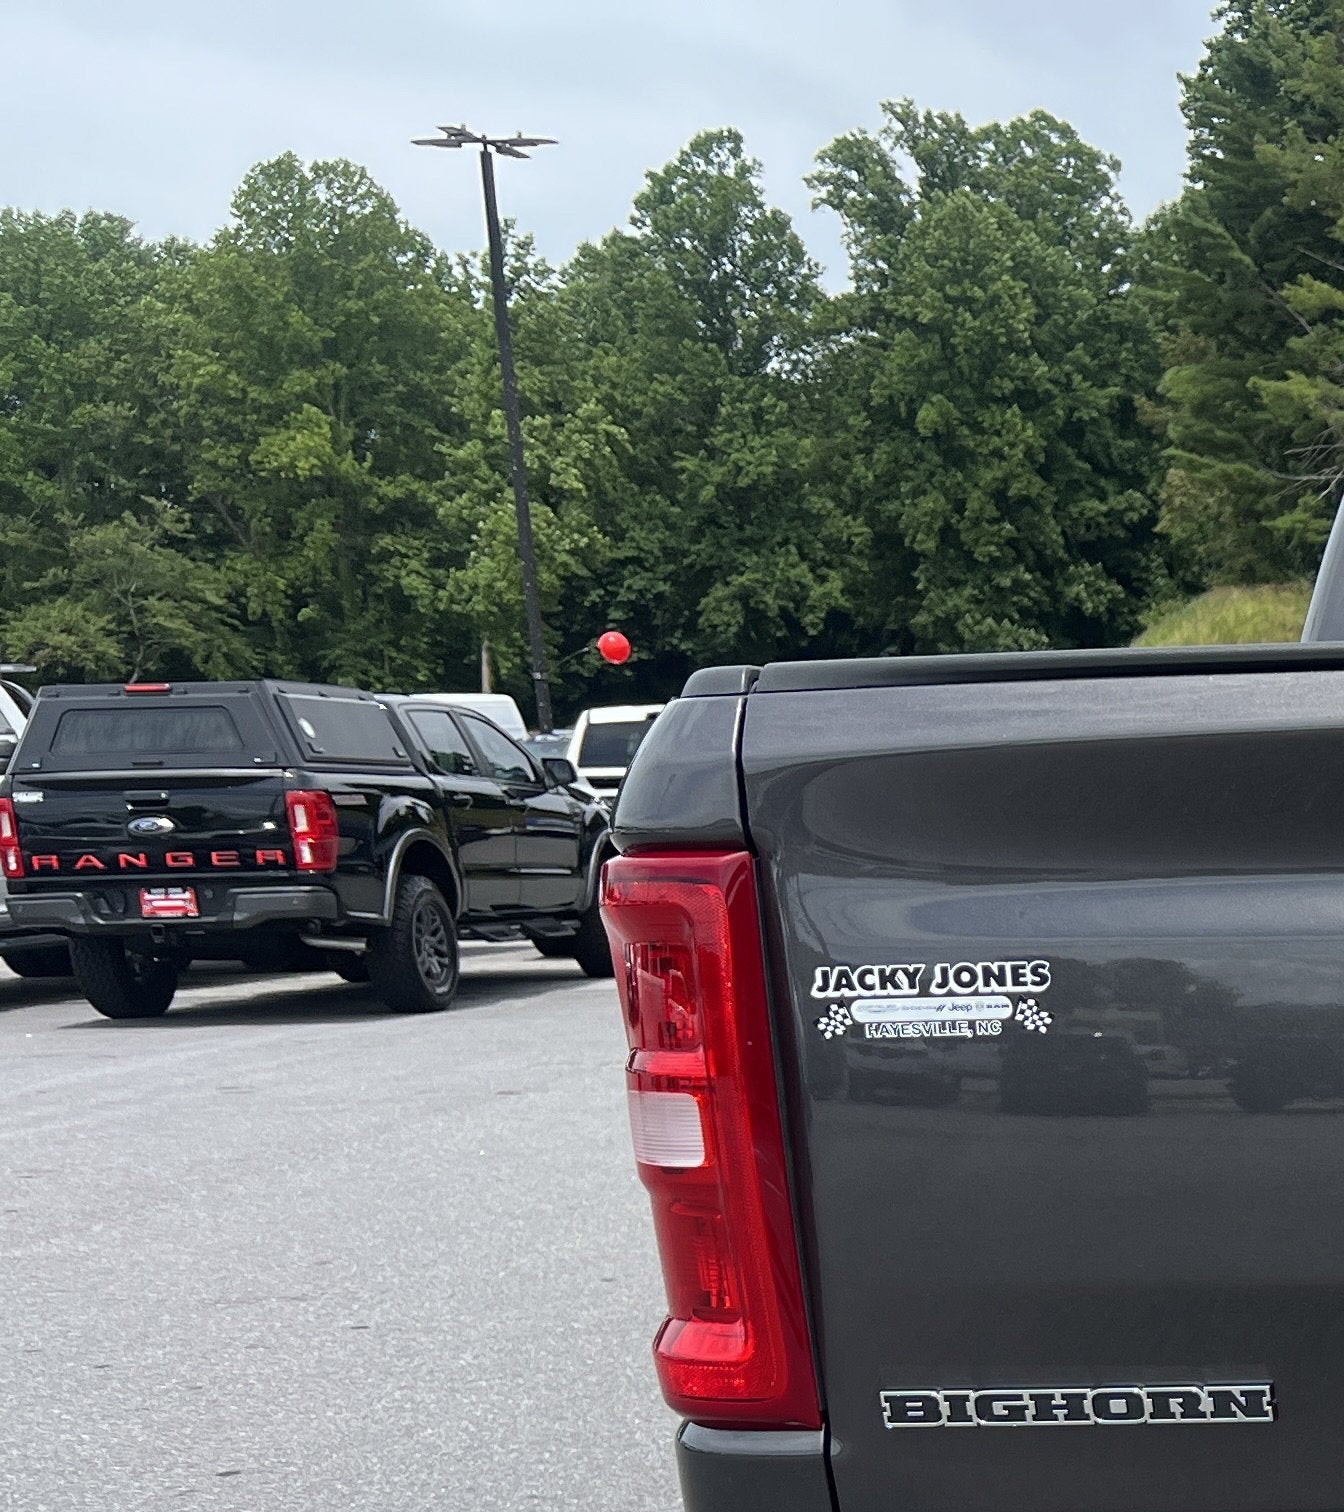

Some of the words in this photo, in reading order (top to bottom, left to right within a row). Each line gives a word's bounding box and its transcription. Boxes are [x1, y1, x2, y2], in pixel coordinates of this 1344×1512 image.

[31, 849, 286, 871] RANGER
[811, 963, 925, 998] JACKY
[929, 960, 1051, 994] JONES
[948, 1002, 973, 1013] Jeep
[864, 1021, 974, 1039] HAYESVILLE,
[976, 1020, 1002, 1036] NC
[879, 1385, 1275, 1428] BIGHORN
